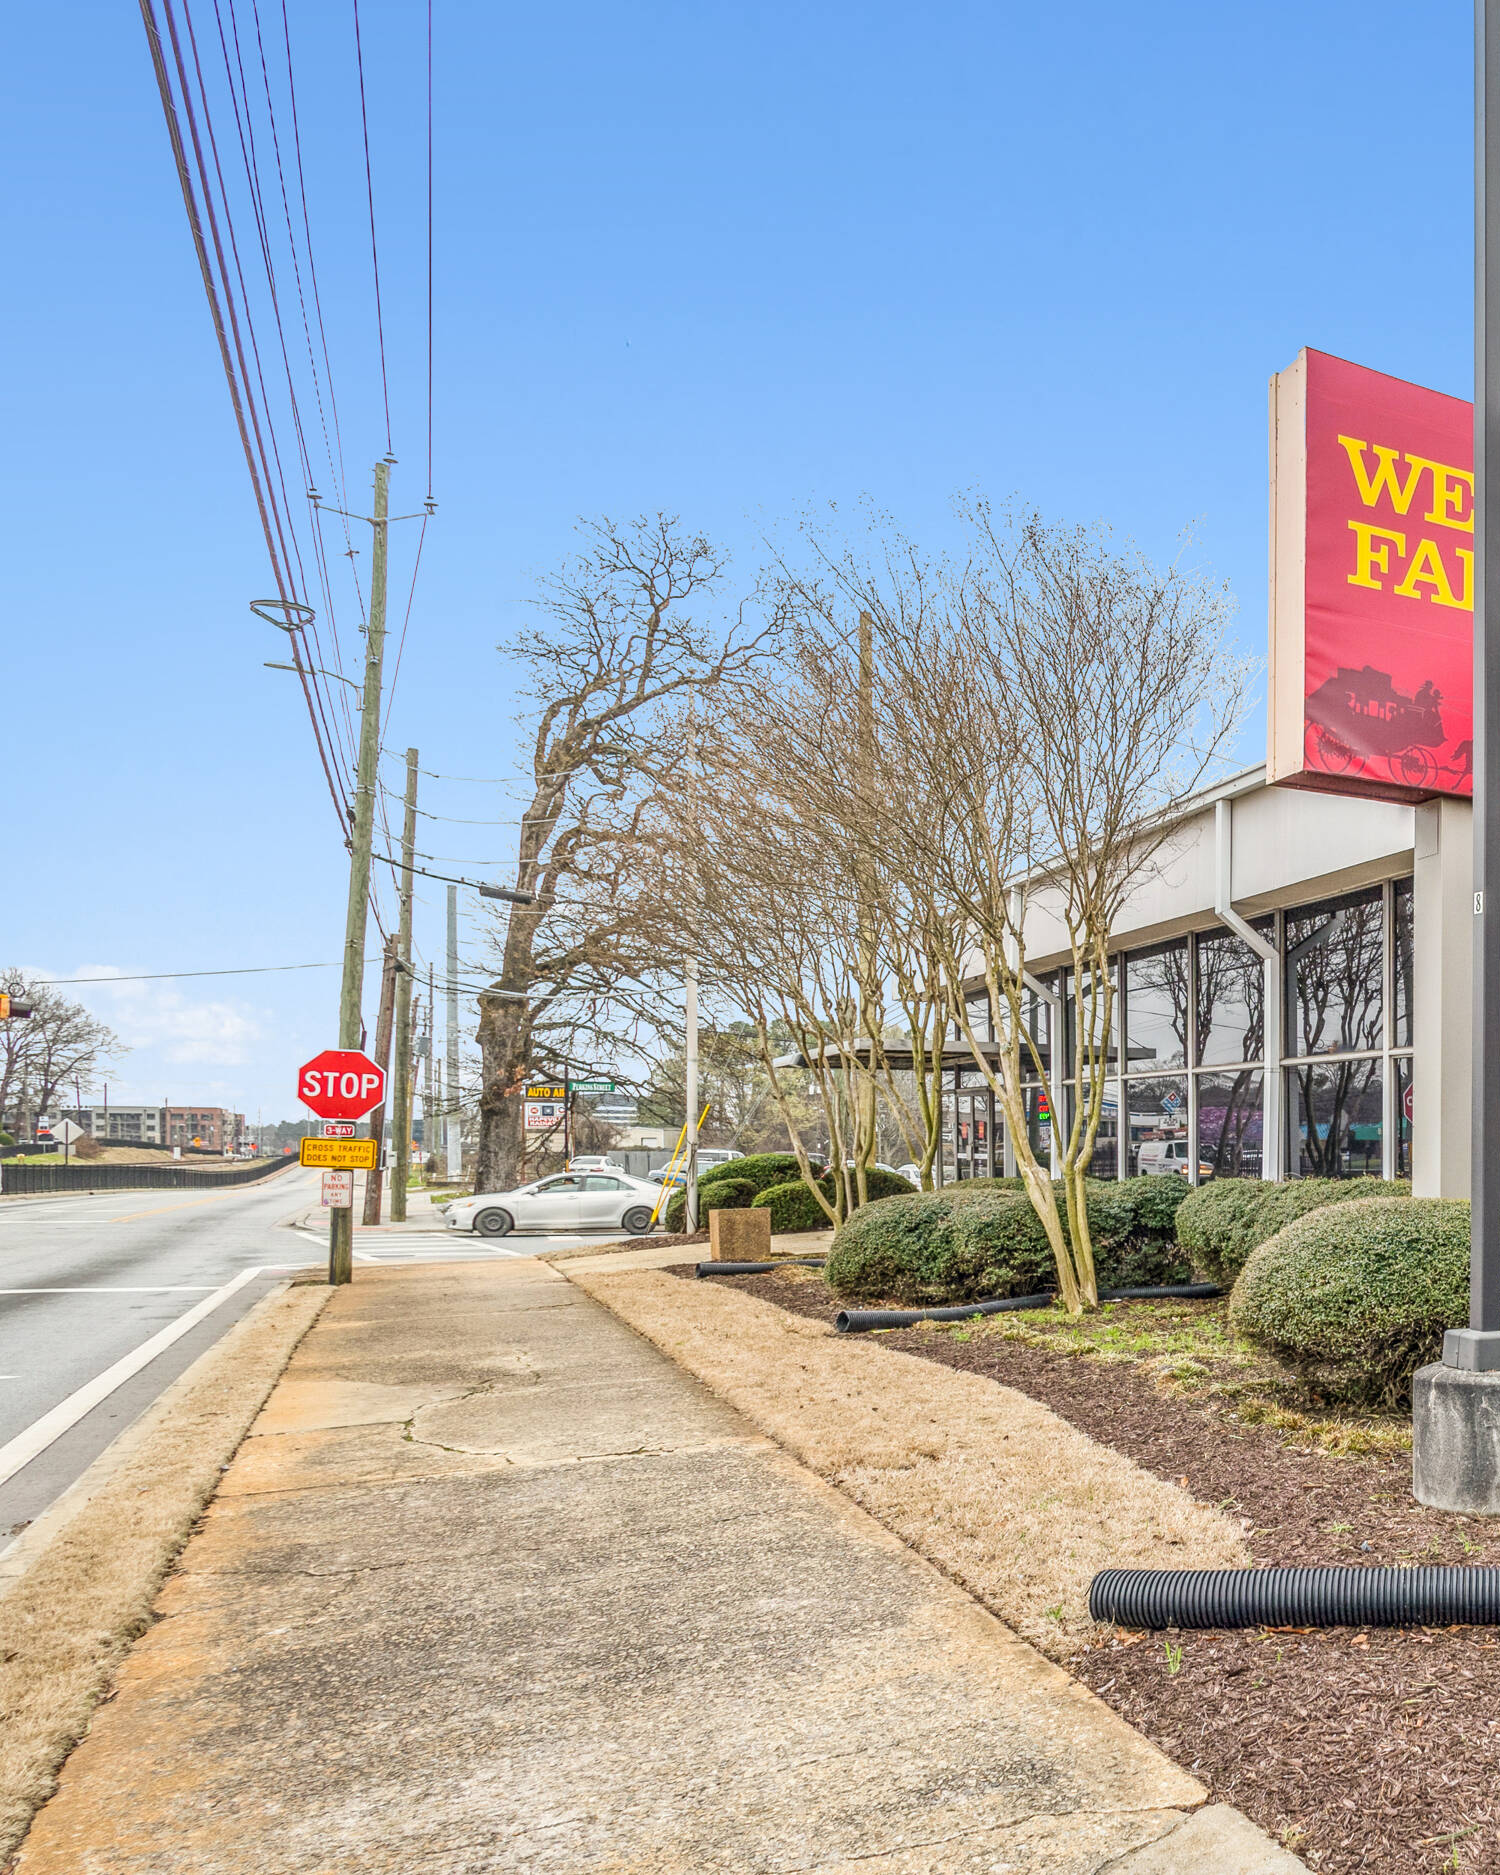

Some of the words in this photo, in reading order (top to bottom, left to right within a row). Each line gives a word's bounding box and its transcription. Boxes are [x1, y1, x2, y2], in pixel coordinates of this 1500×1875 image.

[302, 1070, 380, 1099] STOP
[527, 1087, 551, 1097] AUTO
[326, 1126, 353, 1135] 3-WAY
[306, 1143, 334, 1152] CROSS
[338, 1145, 371, 1154] TRAFFIC
[306, 1153, 328, 1162] DOES
[331, 1155, 346, 1163] NOT
[350, 1155, 370, 1163] STOP
[330, 1174, 342, 1182] NO
